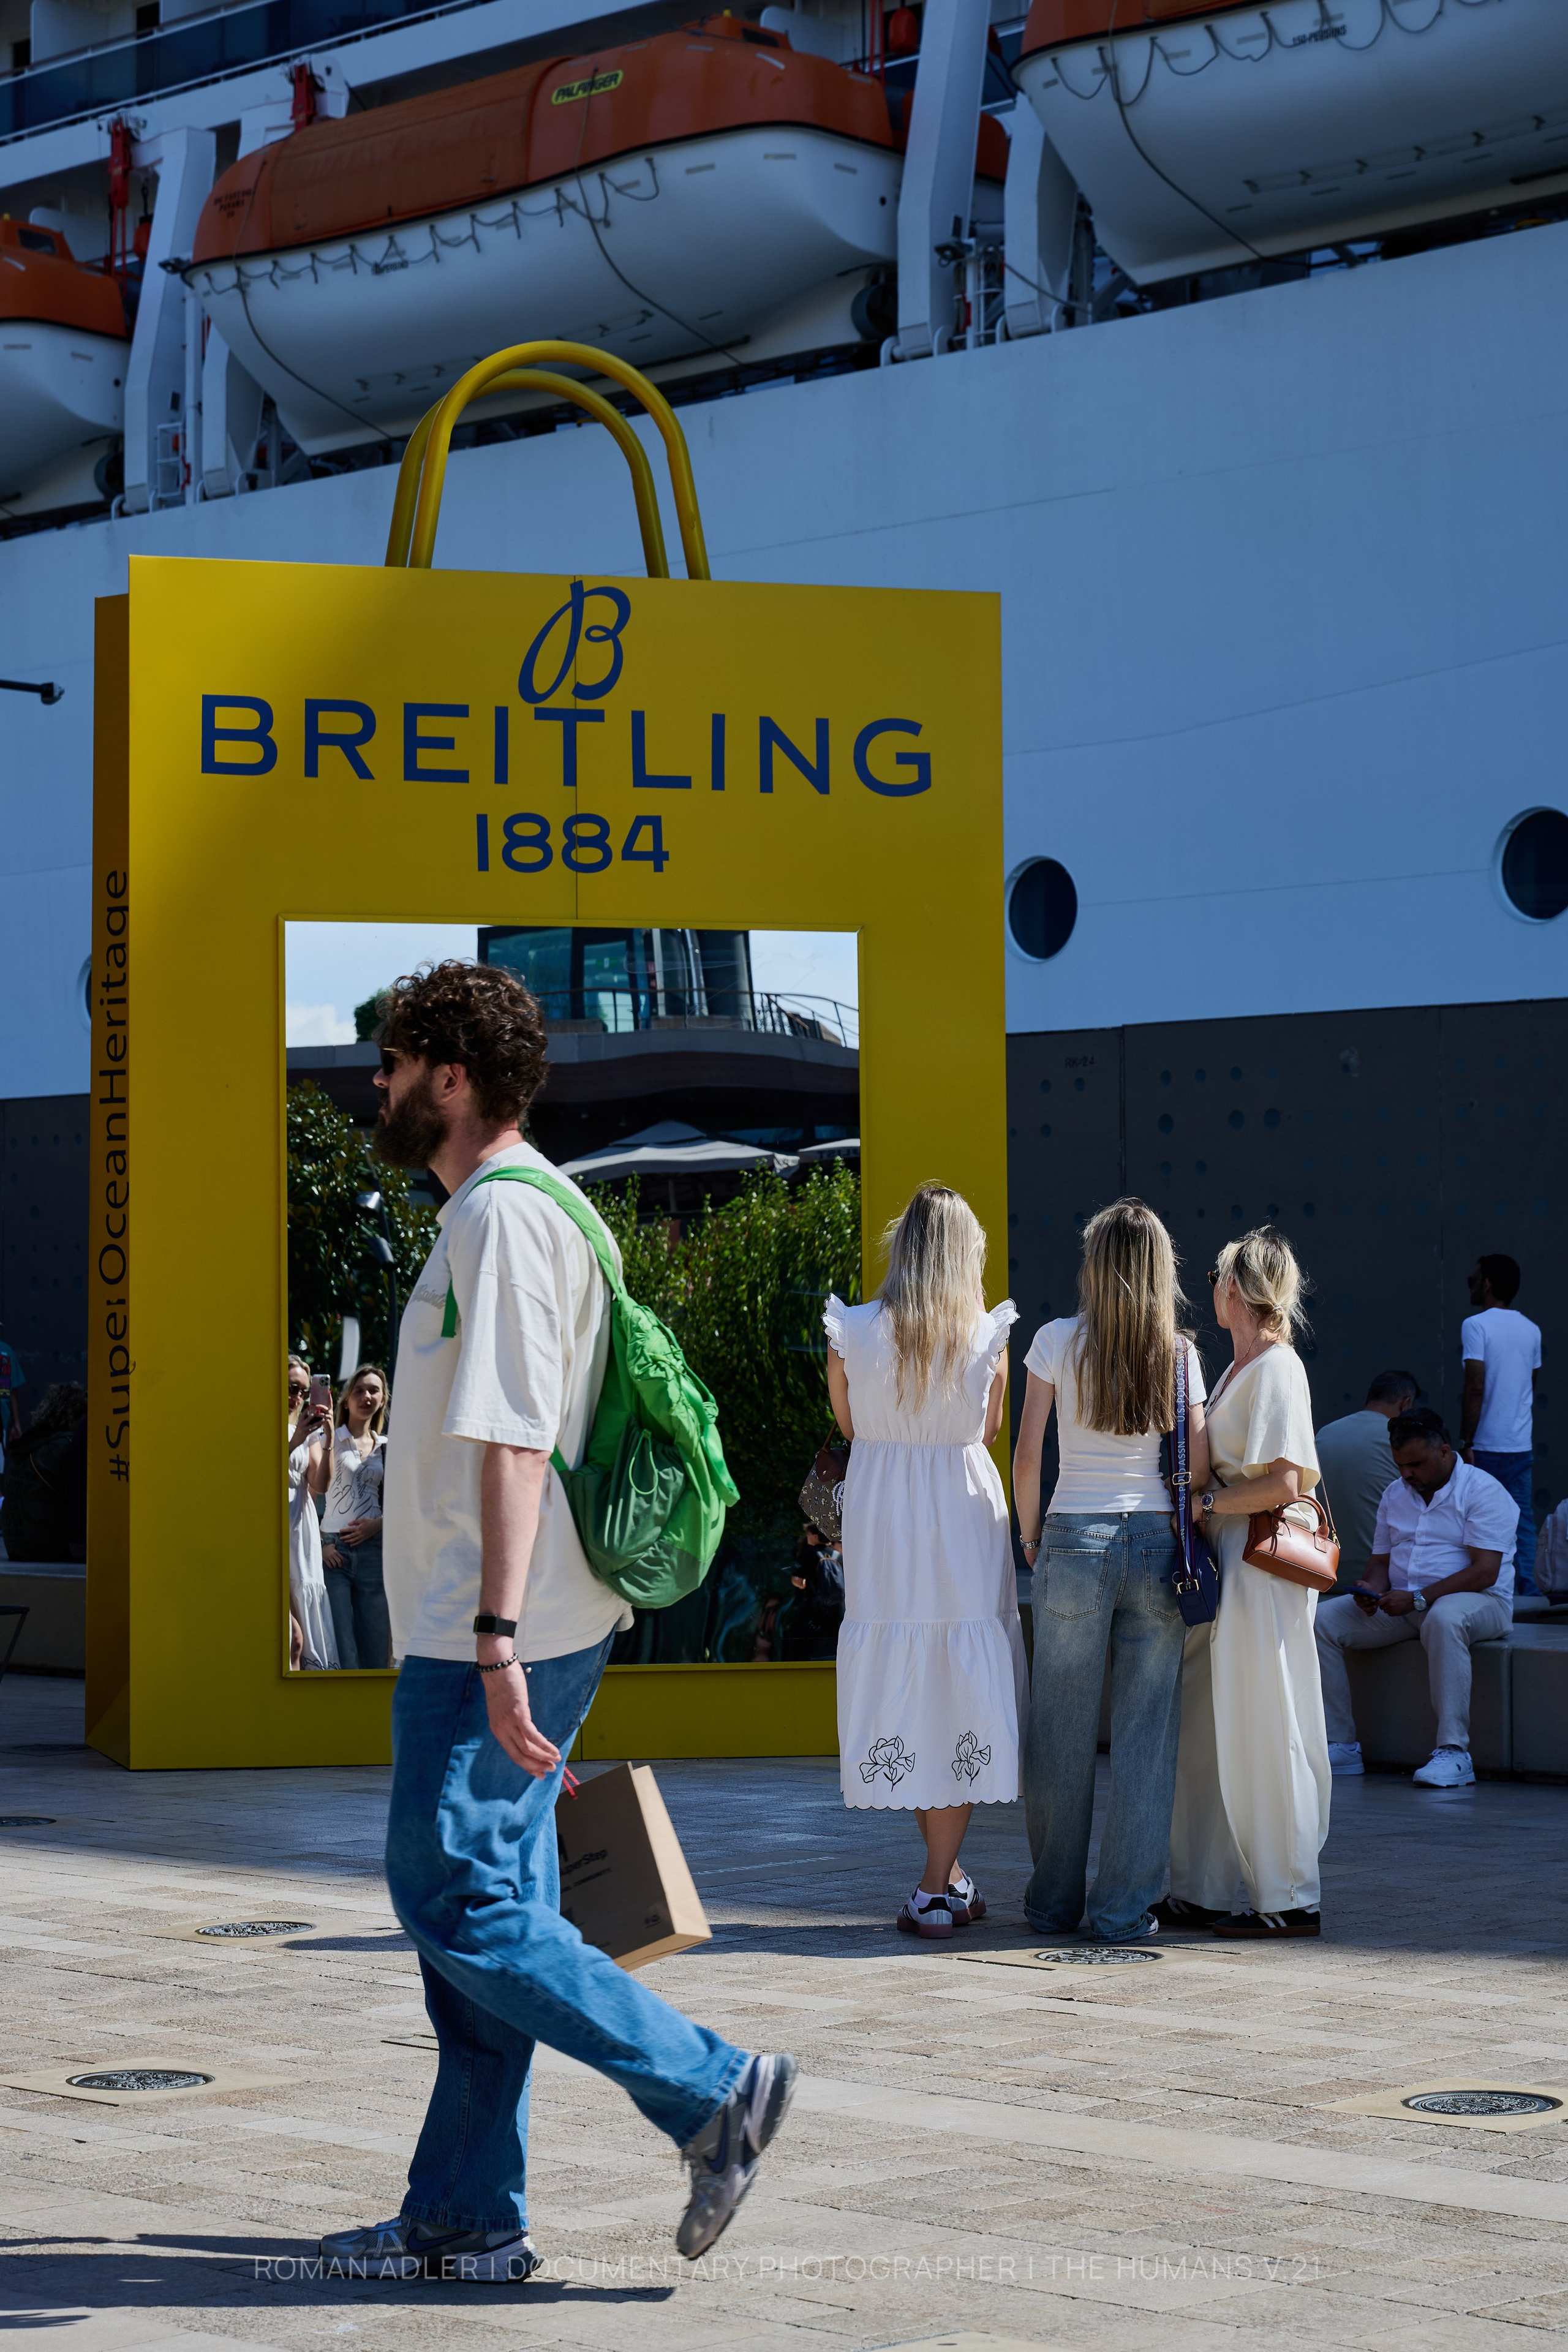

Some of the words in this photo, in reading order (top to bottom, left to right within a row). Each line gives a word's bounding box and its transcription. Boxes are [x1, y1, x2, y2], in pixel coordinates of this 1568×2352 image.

[555, 72, 619, 101] PALFINGER
[518, 581, 630, 704] B
[202, 694, 932, 797] BREITLING
[477, 813, 669, 873] 1884
[1177, 1378, 1185, 1403] POLO
[1177, 1405, 1185, 1422] U.S.
[1177, 1438, 1186, 1465] ASSN.
[560, 1849, 608, 1876] uperStep
